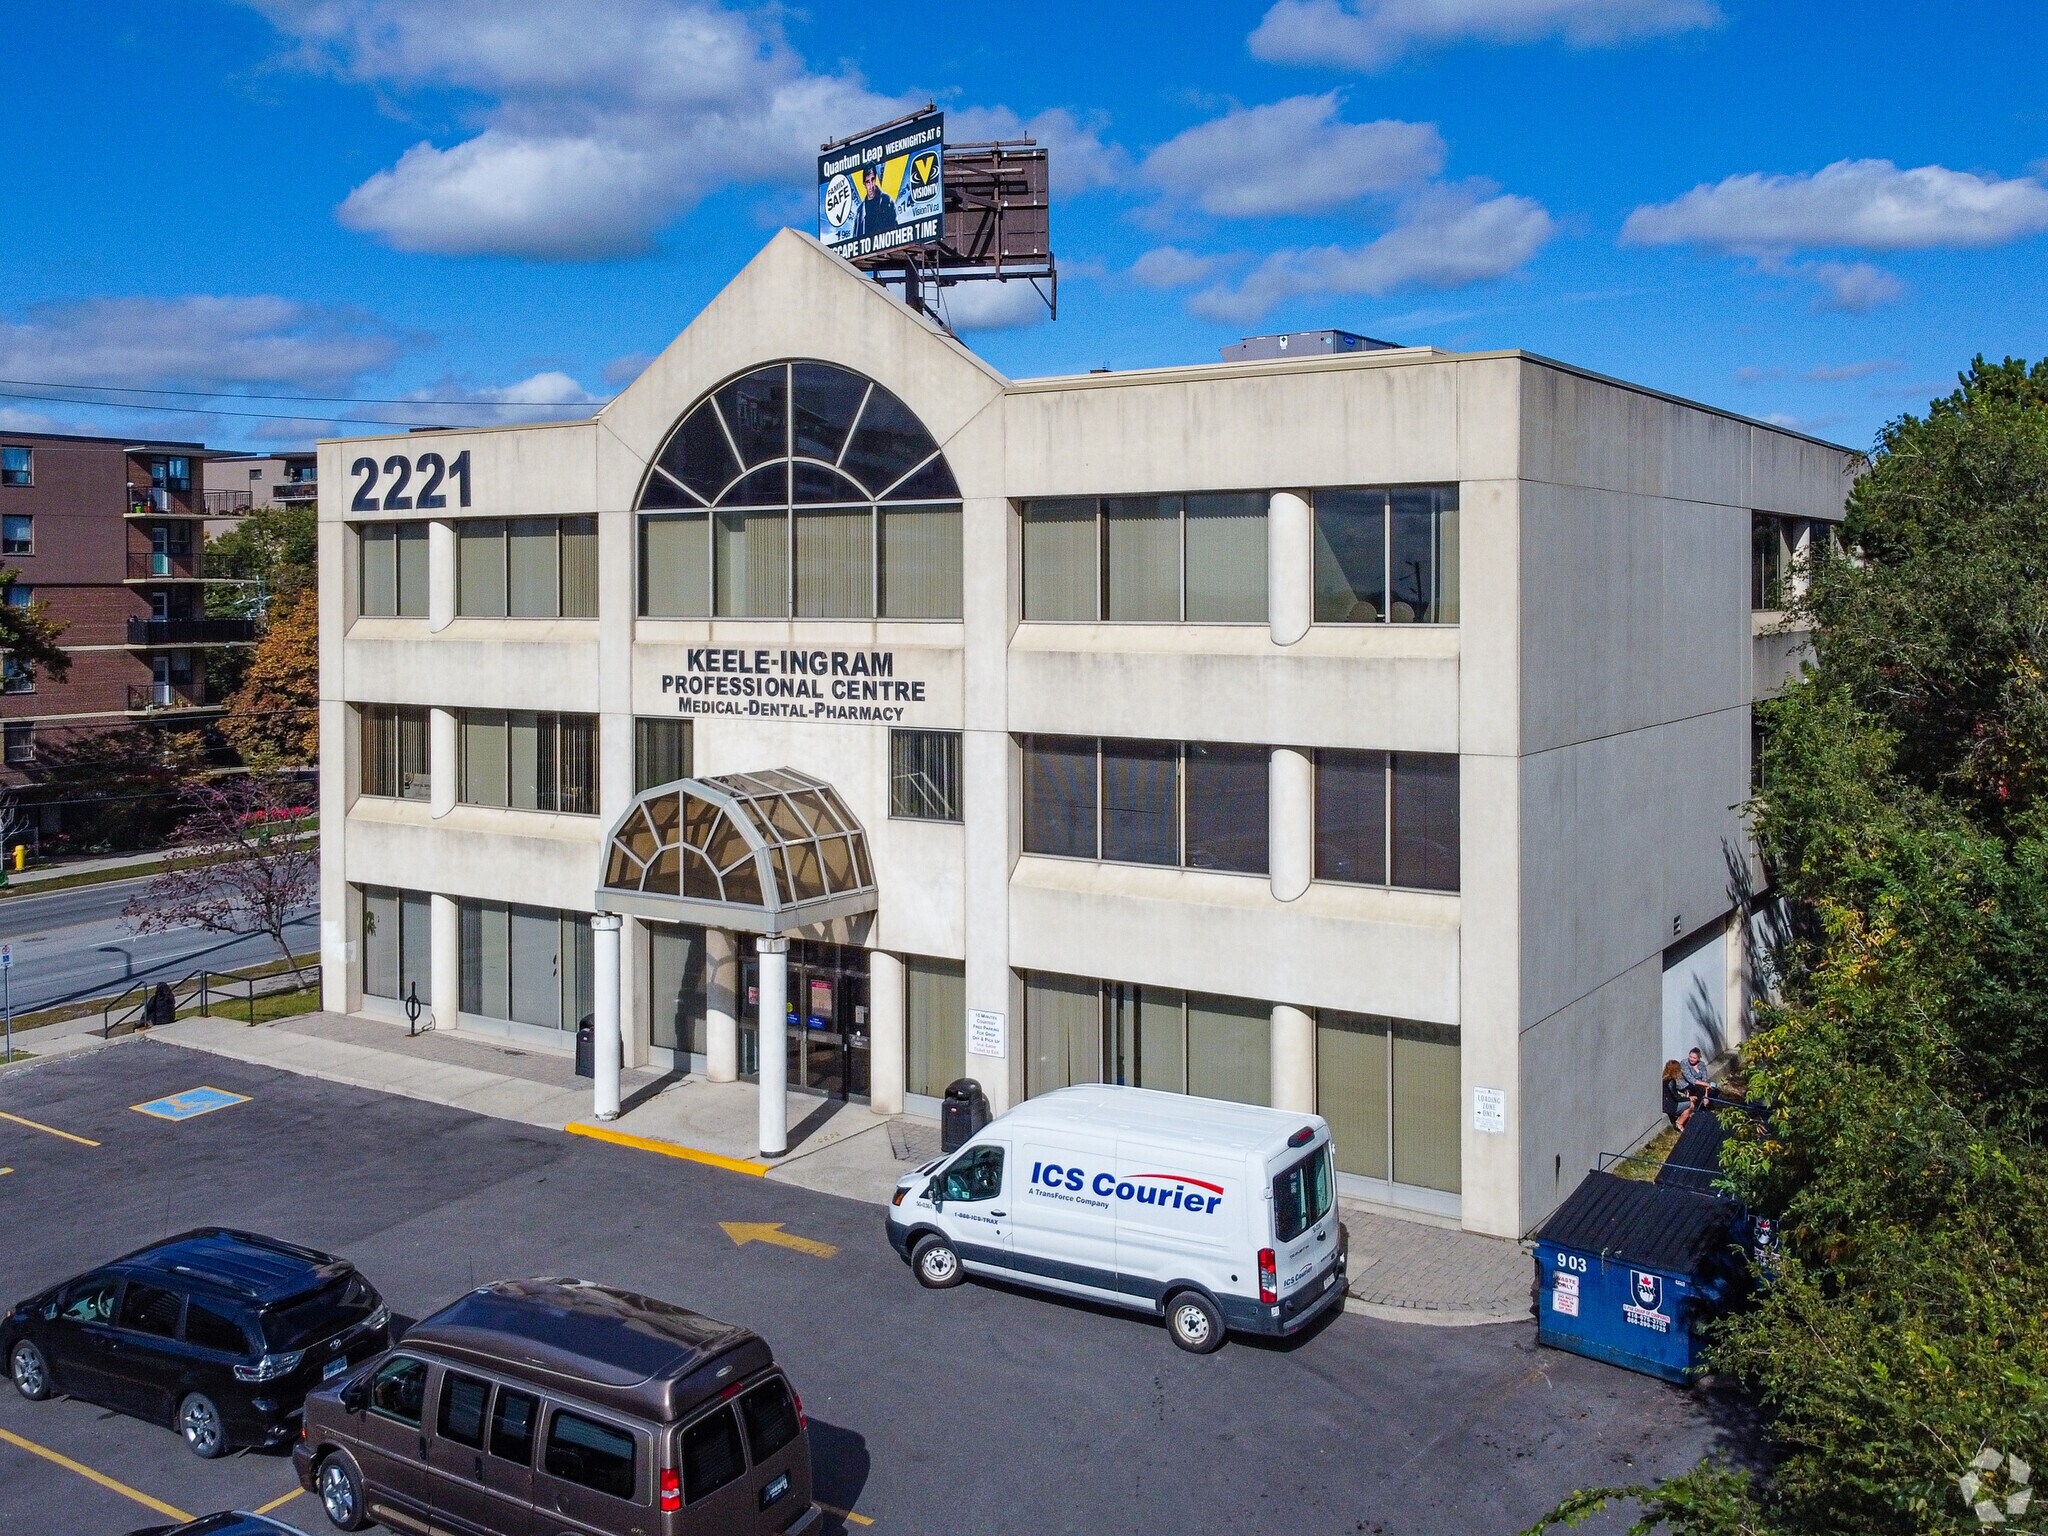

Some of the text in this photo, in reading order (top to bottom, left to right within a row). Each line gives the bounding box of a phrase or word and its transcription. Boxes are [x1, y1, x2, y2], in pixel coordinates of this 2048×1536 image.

[823, 126, 941, 177] Quantum Leap WEEKNIGHTS AT 6
[827, 178, 846, 197] FAMILY
[912, 182, 938, 200] VISIONTV
[827, 185, 850, 212] SAFE
[912, 202, 940, 217] VisionTV.ca
[860, 238, 871, 254] TO
[873, 226, 914, 251] ANOTHER
[915, 219, 938, 239] TIME
[351, 450, 471, 512] 2221
[687, 648, 893, 677] KEELE-INGRAM
[662, 675, 926, 702] PROFESSIONAL CENTRE
[1477, 1094, 1501, 1104] LOADING
[1482, 1102, 1496, 1110] ZONE
[1482, 1109, 1496, 1118] ONLY
[1031, 1161, 1222, 1214] ICS Courier
[1028, 1187, 1110, 1210] A TransForce Company
[1557, 1252, 1587, 1273] 903
[1283, 1275, 1295, 1287] ICS
[1556, 1275, 1576, 1285] WASTE
